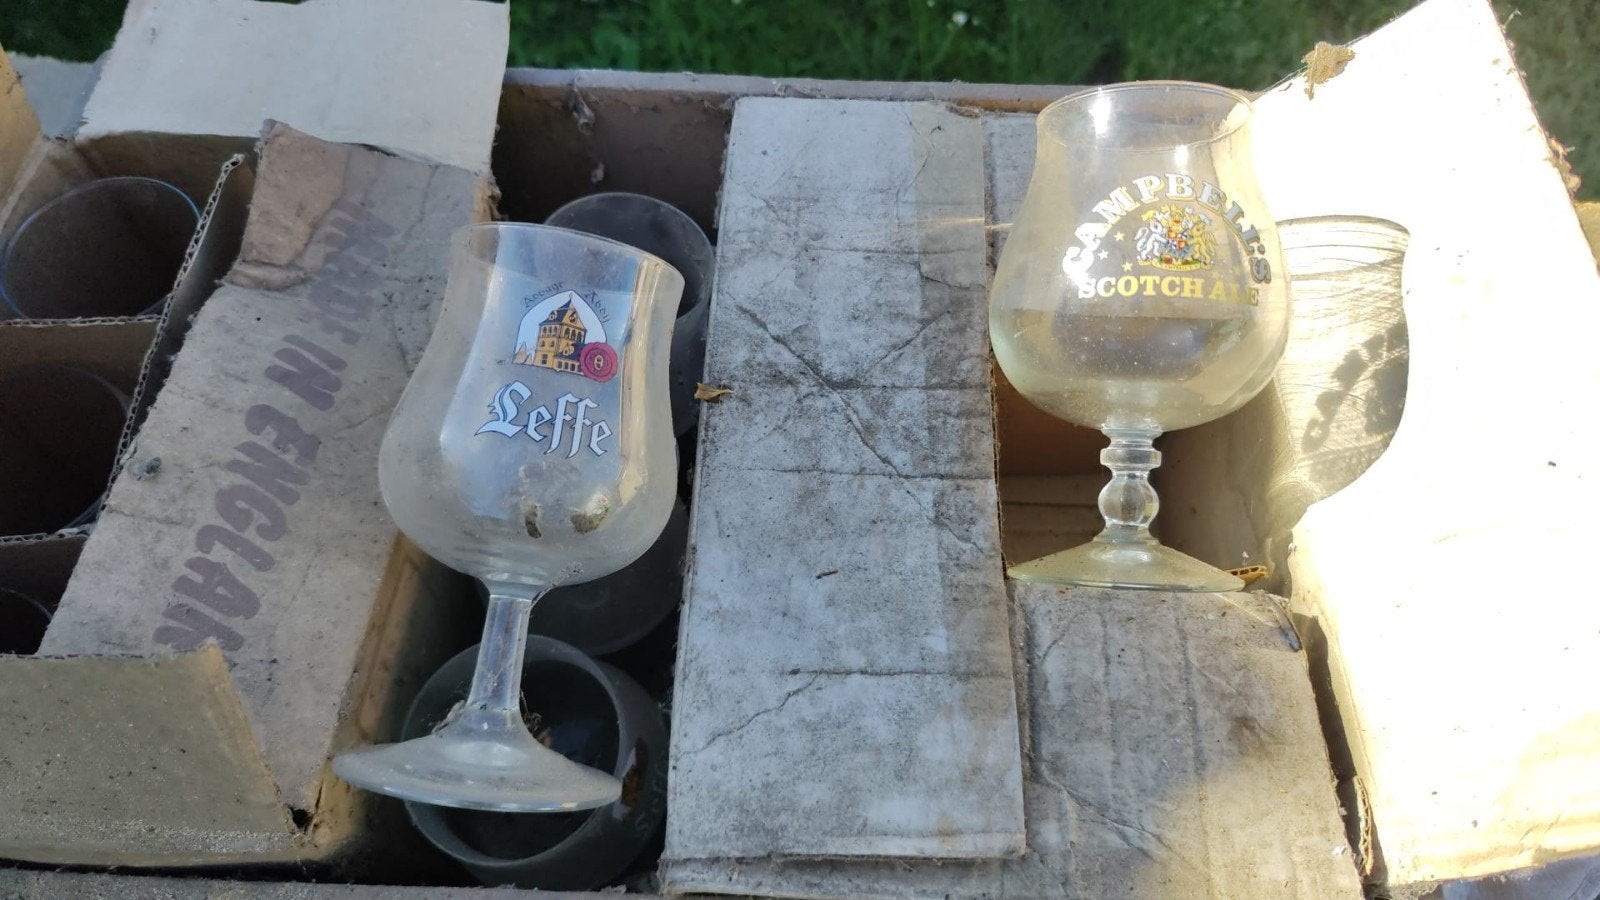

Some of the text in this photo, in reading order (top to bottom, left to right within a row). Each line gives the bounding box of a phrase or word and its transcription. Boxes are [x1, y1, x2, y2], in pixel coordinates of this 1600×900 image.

[1062, 172, 1272, 284] CAMPBELL'S
[1078, 275, 1260, 307] SCOTCH ALE
[264, 334, 347, 411] IN
[474, 379, 613, 460] Leffe
[152, 403, 321, 653] ENGLAN
